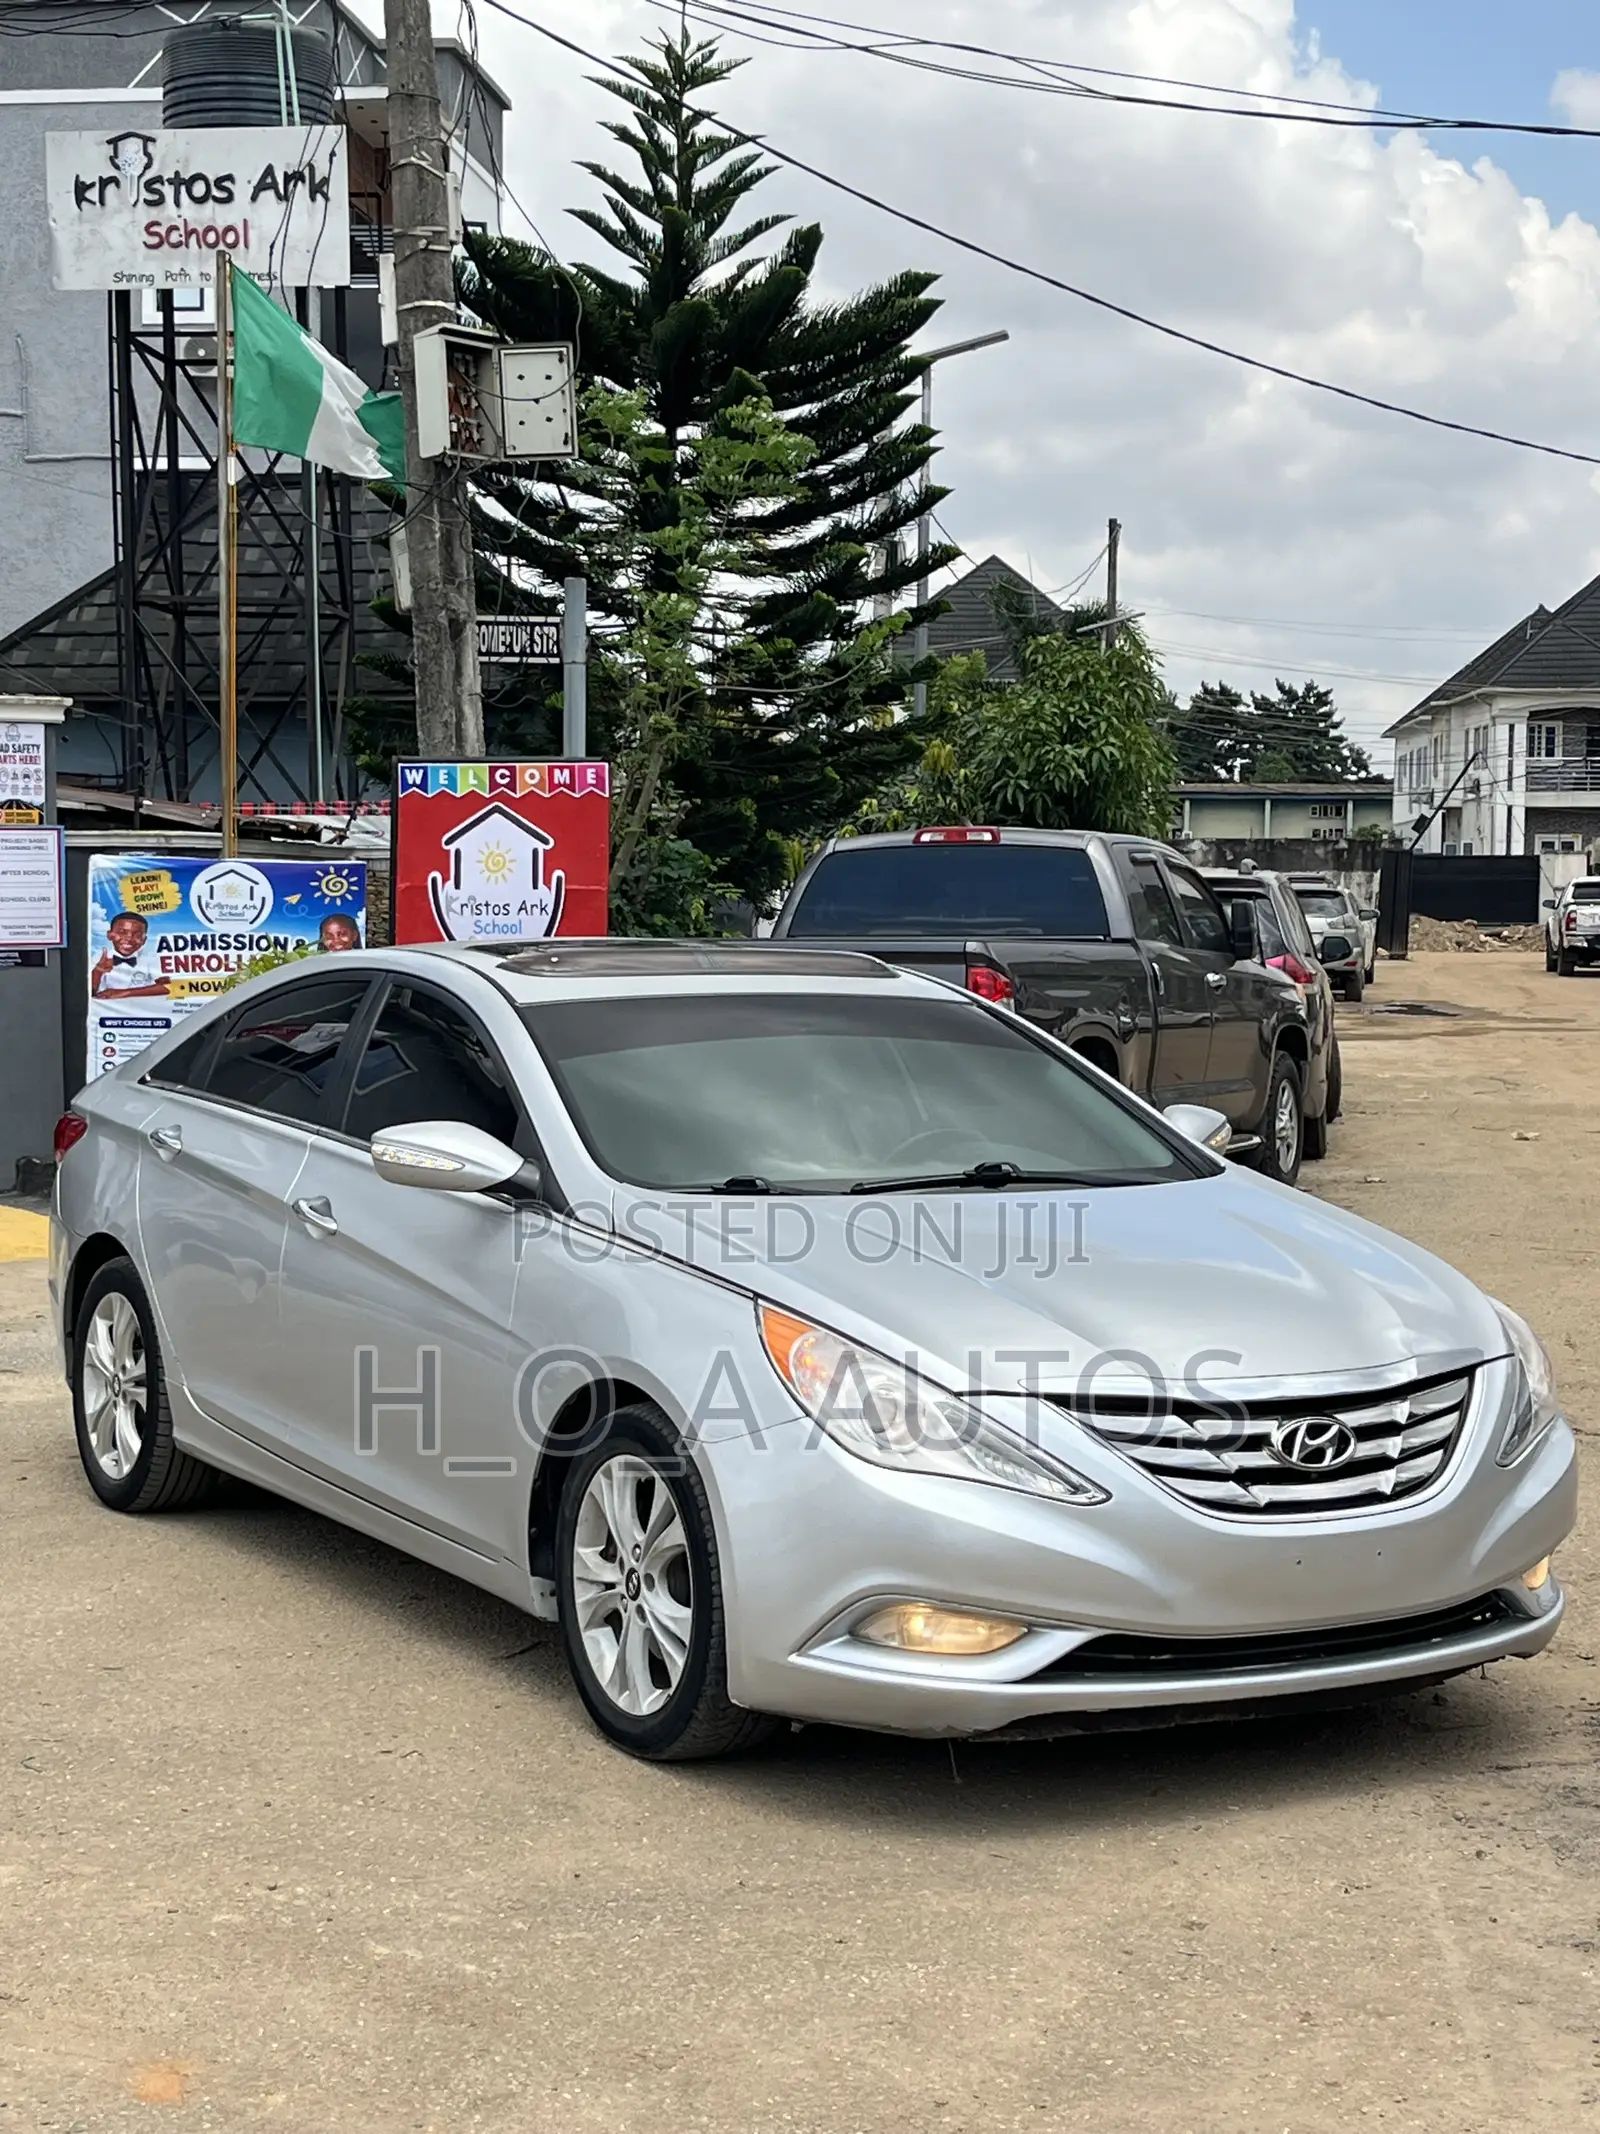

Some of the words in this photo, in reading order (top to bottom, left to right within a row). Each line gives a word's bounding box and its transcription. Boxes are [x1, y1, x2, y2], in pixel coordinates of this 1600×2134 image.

[251, 162, 330, 203] Ark
[143, 218, 250, 250] School
[112, 271, 154, 286] Shining
[200, 271, 212, 282] to
[12, 743, 41, 754] SAFETY
[405, 768, 597, 785] WELCOME
[132, 883, 159, 894] PLAY!
[134, 892, 164, 903] GROW!
[445, 892, 511, 918] Kristos
[517, 899, 549, 916] Ark
[136, 901, 168, 912] SHINE!
[473, 919, 523, 935] School
[157, 933, 289, 953] ADMISSION
[188, 981, 227, 993] NOW
